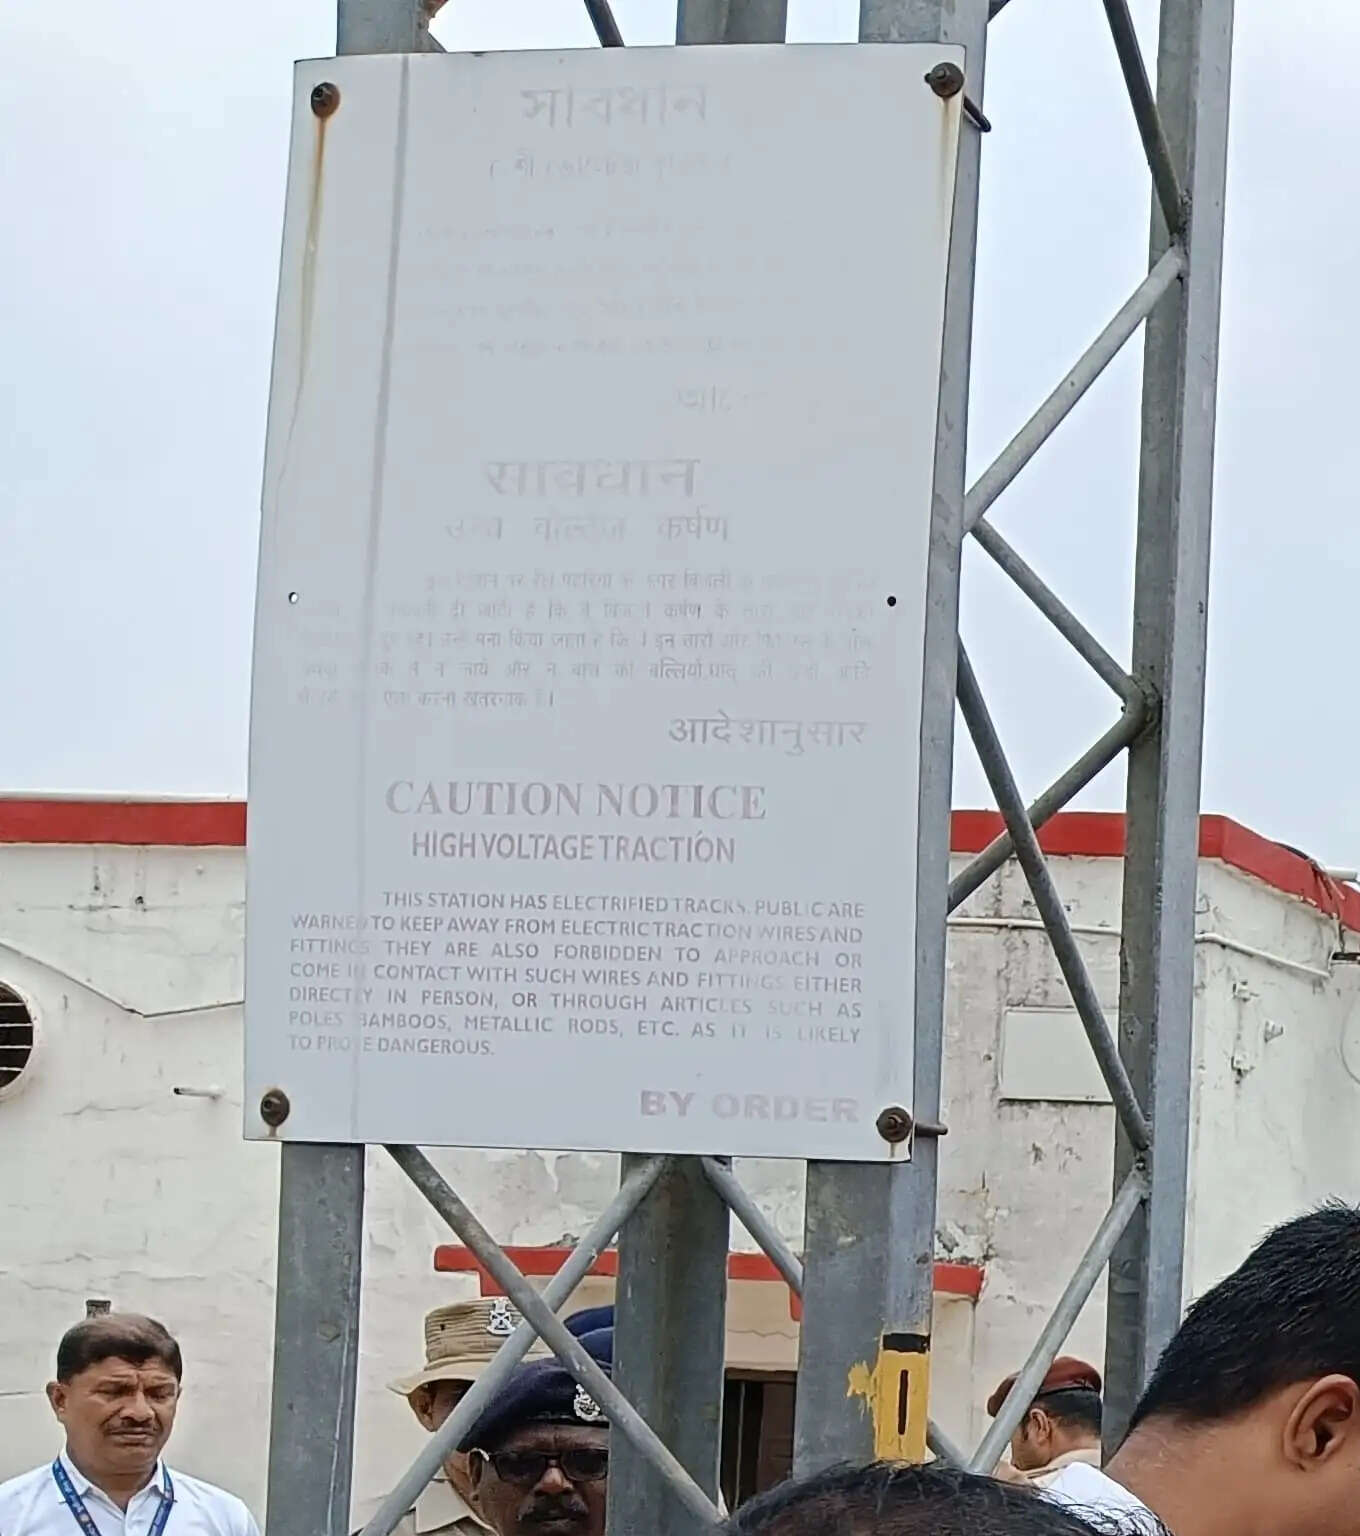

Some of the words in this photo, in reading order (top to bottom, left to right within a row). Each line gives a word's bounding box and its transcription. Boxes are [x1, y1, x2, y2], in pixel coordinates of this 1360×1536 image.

[483, 458, 701, 498] सावधान
[668, 708, 869, 757] आदेशानुसार
[385, 780, 584, 816] CAUTION
[596, 783, 766, 820] NOTICE
[411, 831, 476, 858] HIGH
[480, 832, 595, 861] VOLTAGE
[598, 834, 735, 863] TRACTION
[383, 891, 424, 908] THIS
[427, 892, 505, 909] STATION
[509, 893, 548, 910] HAS
[552, 895, 669, 913] ELECTRIFIED
[827, 901, 865, 918] ARE
[370, 915, 396, 931] TO
[400, 915, 443, 932] KEEP
[446, 916, 501, 933] AWAY
[504, 917, 555, 935] FROM
[560, 919, 650, 938] ELECTRIC
[652, 921, 752, 941] TRACTION
[759, 925, 816, 943] WIRES
[820, 926, 864, 944] AND
[386, 940, 432, 957] THEY
[445, 941, 479, 958] ARE
[491, 942, 539, 960] ALSO
[553, 944, 662, 962] FORBIDDEN
[674, 946, 701, 964] TO
[714, 949, 820, 967] APPROACH
[834, 952, 864, 970] OR
[289, 962, 341, 980] COME
[373, 964, 462, 982] CONTACT
[465, 965, 517, 983] WITH
[525, 967, 577, 985] SUCH
[582, 969, 640, 987] WIRES
[646, 970, 690, 988] AND
[696, 971, 786, 990] FITTINGS
[793, 975, 862, 993] EITHER
[289, 986, 373, 1004] DIRECTY
[387, 987, 407, 1005] IN
[421, 989, 499, 1010] PERSON,
[511, 991, 538, 1009] OR
[550, 992, 648, 1012] THROUGH
[659, 995, 753, 1015] ARTICLES
[768, 999, 823, 1017] SUCH
[836, 1001, 861, 1019] AS
[464, 1015, 554, 1033] METALLIC
[568, 1018, 624, 1038] RODS,
[637, 1020, 680, 1038] ETC.
[691, 1022, 716, 1039] AS
[797, 1026, 861, 1044] LIKELY
[290, 1034, 313, 1052] TO
[317, 1036, 373, 1054] PROE
[377, 1037, 496, 1057] DANGEROUS.
[640, 1089, 695, 1118] BY
[711, 1092, 860, 1124] ORDER
